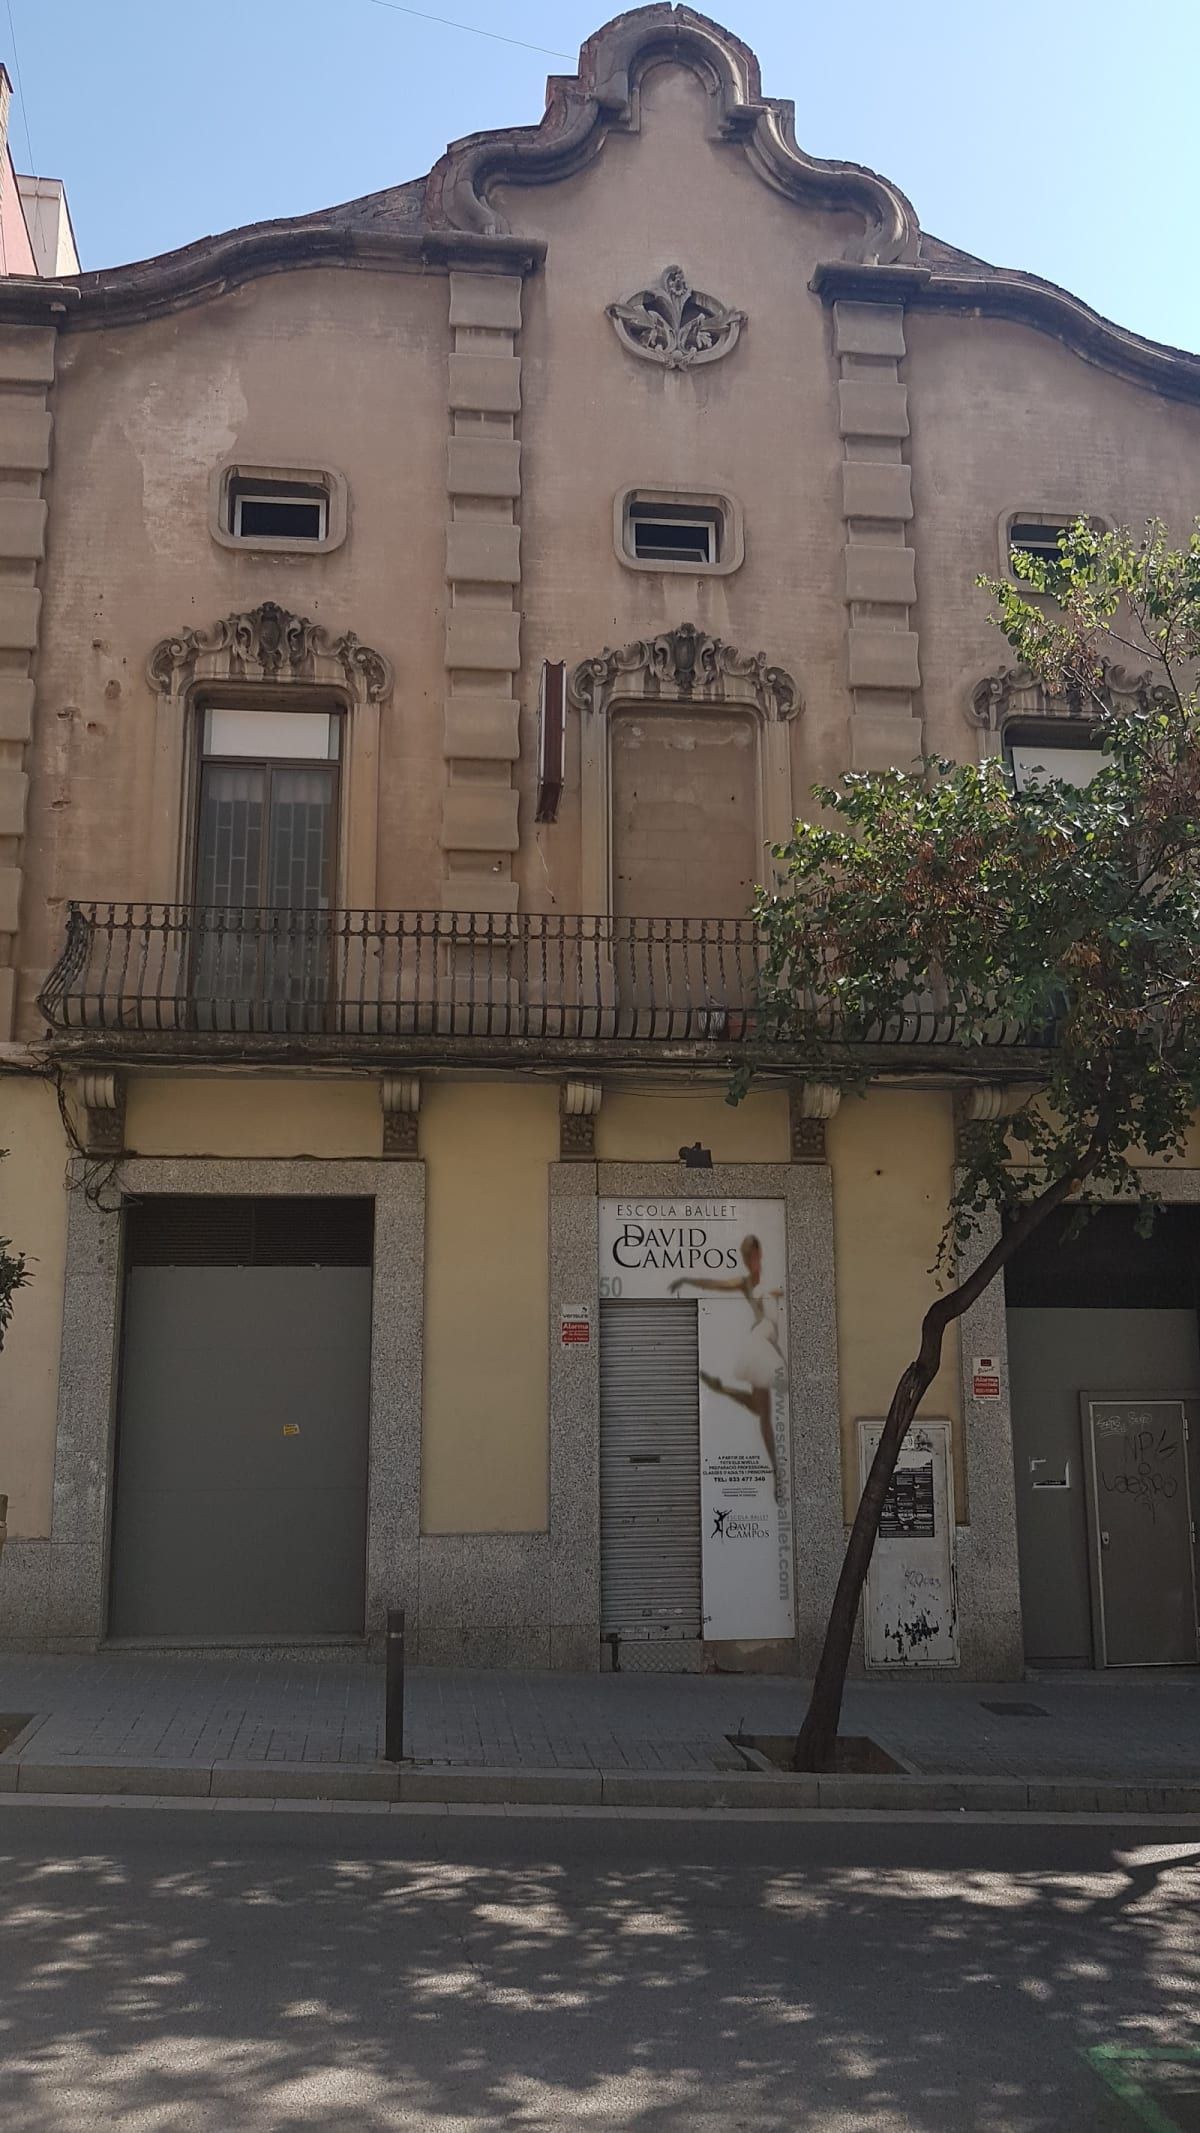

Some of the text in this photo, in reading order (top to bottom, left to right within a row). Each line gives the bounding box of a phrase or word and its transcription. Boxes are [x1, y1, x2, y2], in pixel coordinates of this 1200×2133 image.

[617, 1204, 737, 1217] ESCOLA BALLET
[623, 1223, 707, 1248] DAVID
[612, 1235, 738, 1269] CAMPOS
[599, 1276, 623, 1297] 50
[725, 1526, 770, 1538] CAMPOS
[729, 1522, 759, 1531] DAVID
